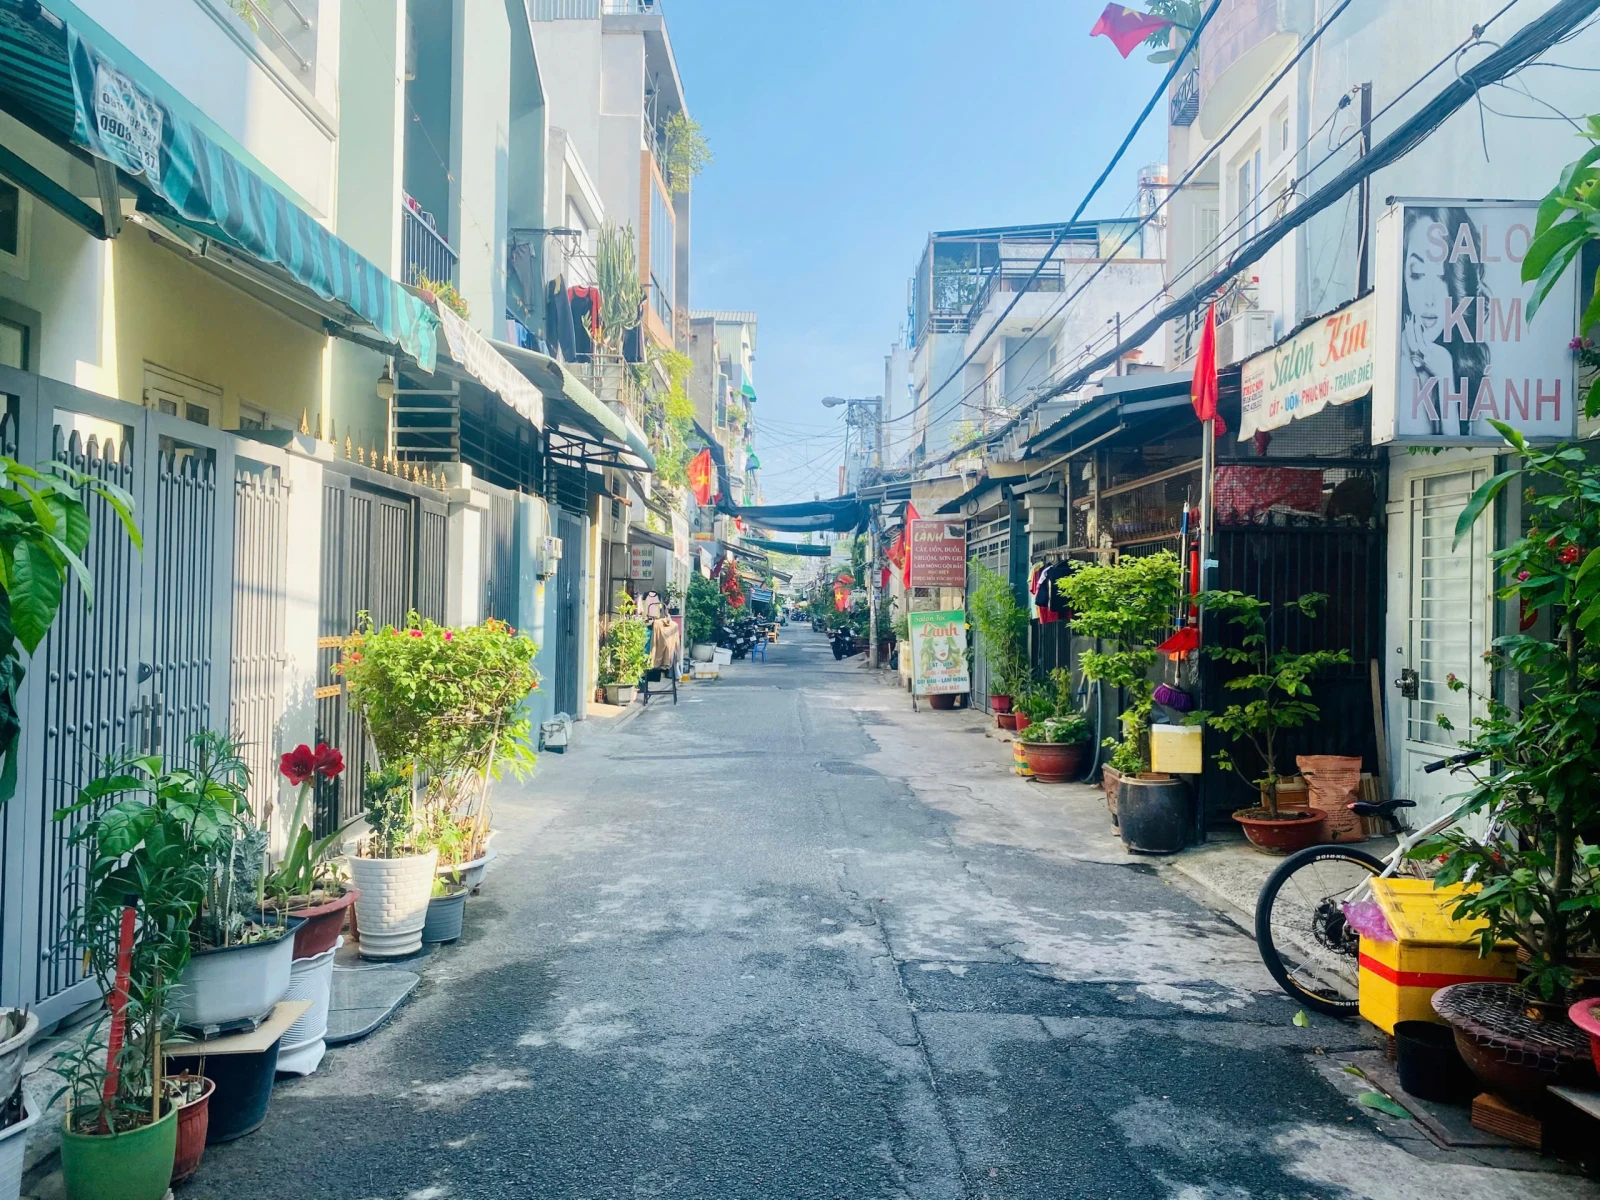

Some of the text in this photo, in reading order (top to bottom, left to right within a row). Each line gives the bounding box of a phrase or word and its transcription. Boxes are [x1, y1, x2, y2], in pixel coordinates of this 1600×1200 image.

[1425, 222, 1532, 264] SALO
[1443, 296, 1522, 344] KIM
[1269, 312, 1369, 392] Salon Kim
[1334, 369, 1357, 393] TRANG
[1411, 364, 1561, 422] KHÁNH
[914, 530, 944, 542] LÀNH
